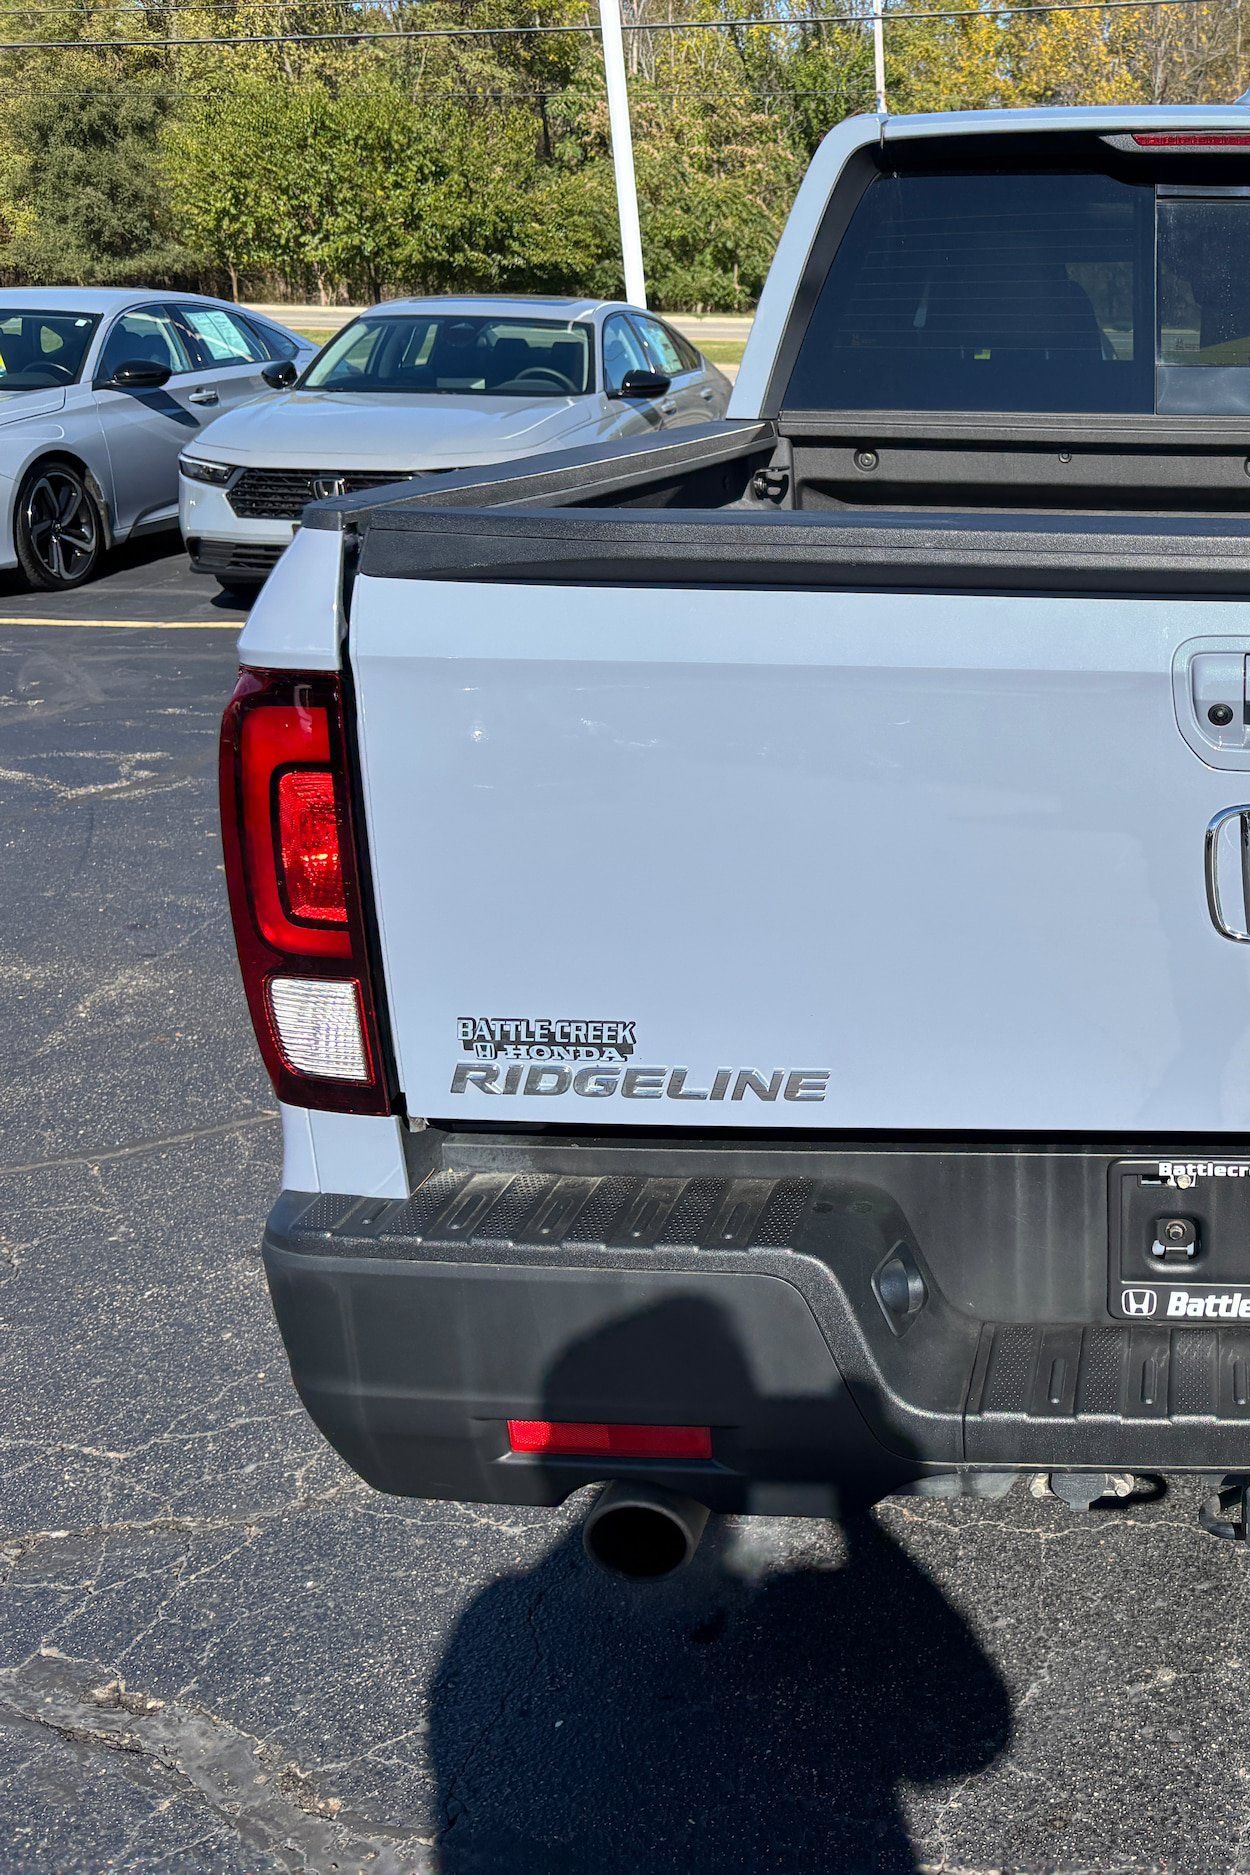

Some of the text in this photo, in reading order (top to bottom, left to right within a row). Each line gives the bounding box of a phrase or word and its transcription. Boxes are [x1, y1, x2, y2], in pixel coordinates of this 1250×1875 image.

[456, 1016, 637, 1045] BATTLE CREEK
[503, 1044, 629, 1063] HONDA
[449, 1063, 832, 1102] RIDGELINE
